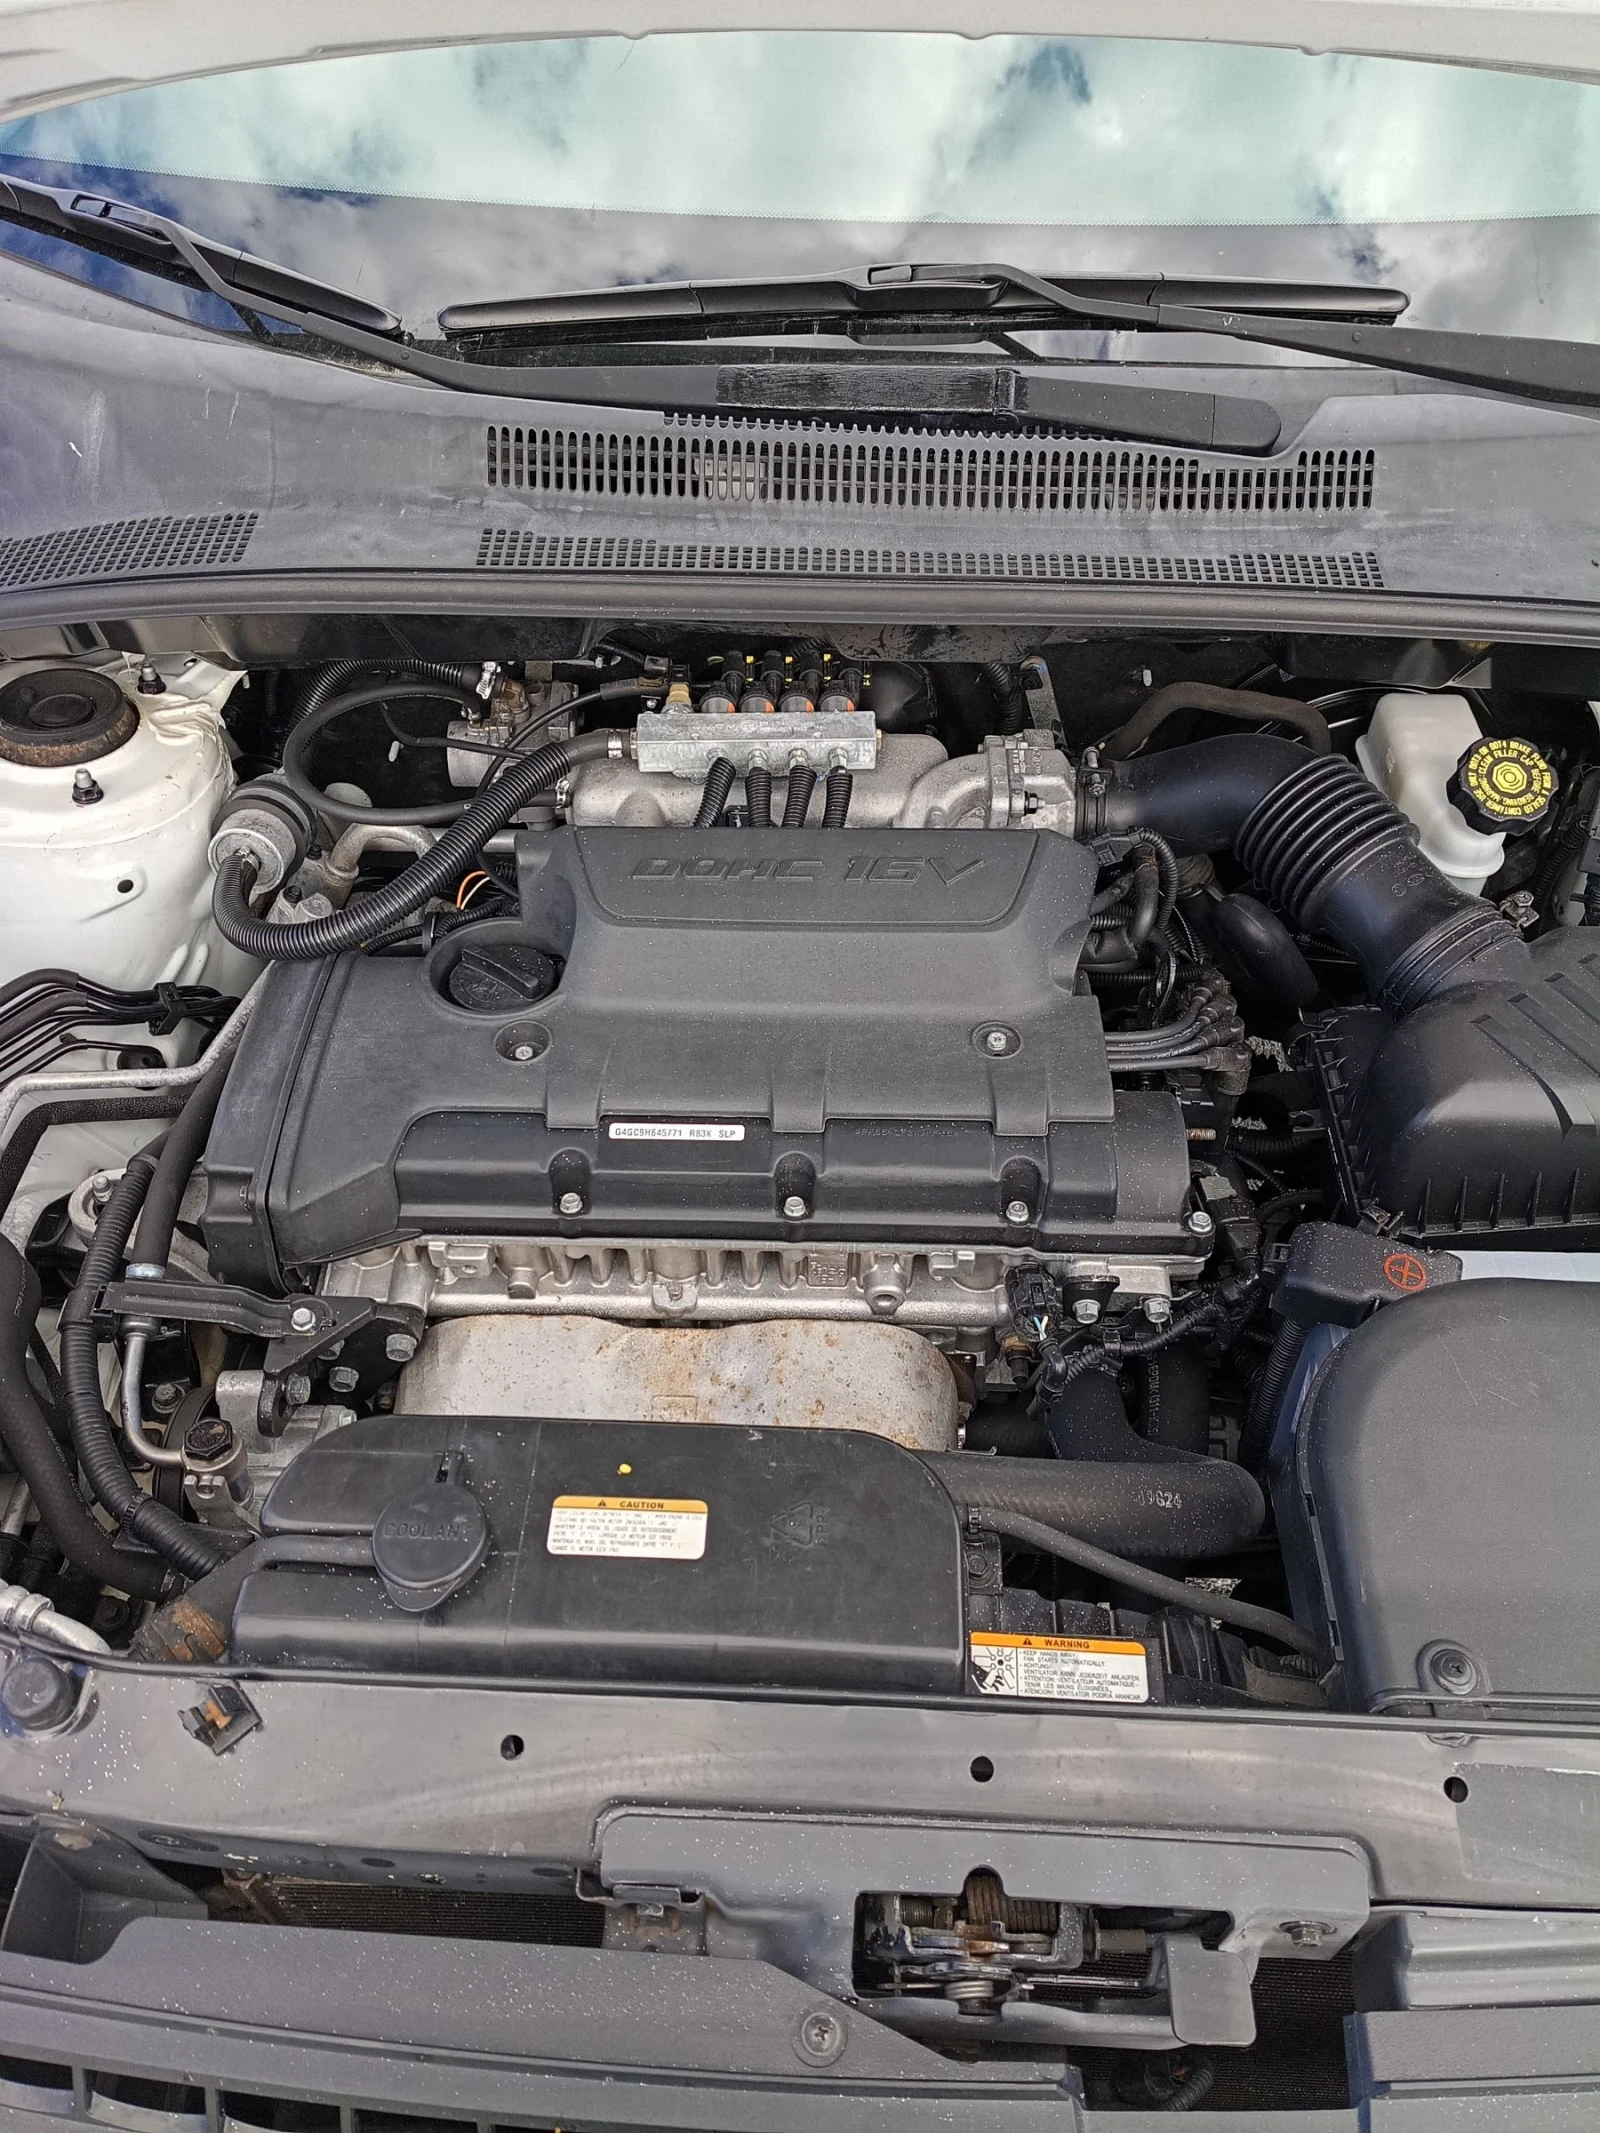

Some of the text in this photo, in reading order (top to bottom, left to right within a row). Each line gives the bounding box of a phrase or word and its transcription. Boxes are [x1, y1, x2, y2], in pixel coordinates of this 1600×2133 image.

[1479, 746, 1489, 755] OR
[1489, 740, 1507, 751] DOT4
[1510, 741, 1532, 754] BRAKE
[1531, 753, 1547, 770] FLUID
[1478, 755, 1494, 774] CLEAN
[1493, 749, 1518, 758] FILLER
[1520, 755, 1534, 766] CAP
[1531, 768, 1541, 793] BEFORE
[632, 858, 985, 886] DOHC 16V
[615, 1128, 736, 1138] G4GC9H645771 R83K SLP
[620, 1500, 664, 1509] CAUTION
[384, 1522, 475, 1540] COOLANT
[1044, 1640, 1090, 1649] WARNING
